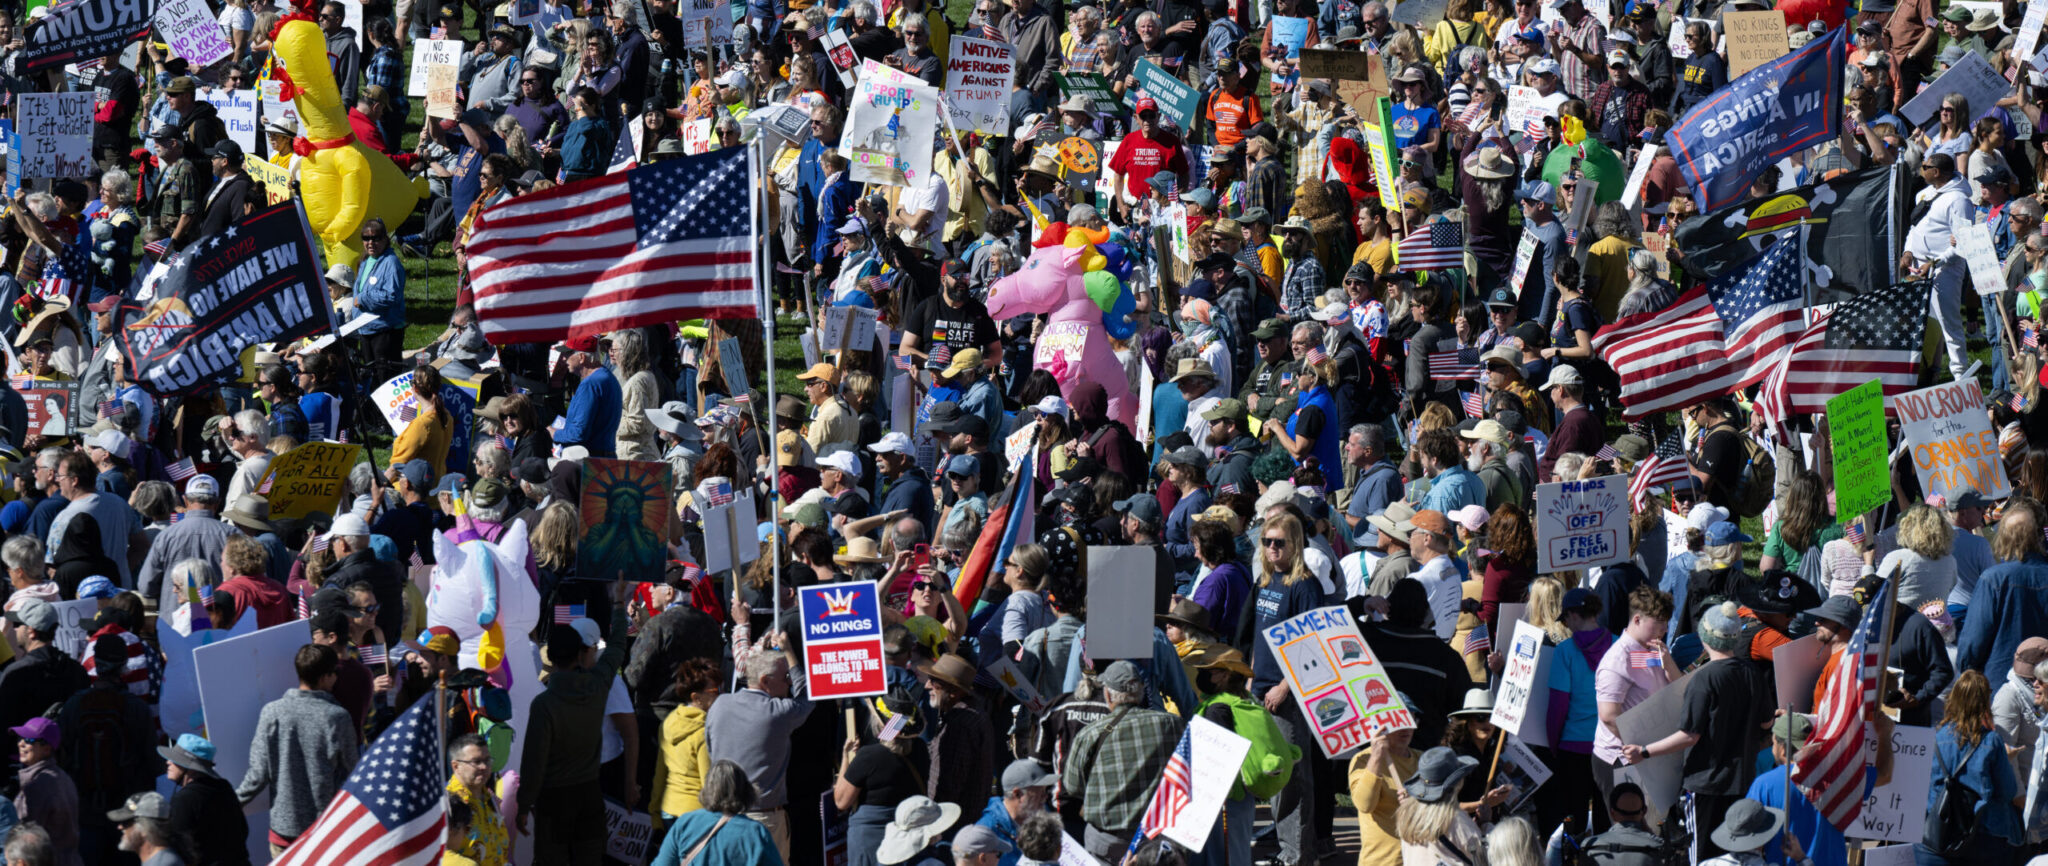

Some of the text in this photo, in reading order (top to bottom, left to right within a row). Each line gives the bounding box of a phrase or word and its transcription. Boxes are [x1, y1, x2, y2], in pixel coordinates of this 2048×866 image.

[1733, 17, 1780, 32] NO KINGS
[171, 18, 219, 54] NO KING
[195, 31, 222, 54] KKK
[1736, 32, 1784, 44] NO DICTATORS
[433, 41, 444, 52] NO
[961, 41, 1010, 59] NATIVE
[1741, 47, 1781, 61] NO FELONS
[422, 53, 450, 64] KINGS
[947, 58, 1012, 74] AMERICANS
[961, 75, 1008, 88] AGAINST
[1145, 67, 1175, 92] EQUALITY
[1172, 84, 1189, 99] AND
[953, 89, 1003, 101] TRUMP
[1146, 80, 1163, 96] LOVE
[1161, 92, 1180, 106] OVER
[25, 96, 50, 117] It's
[214, 96, 252, 112] good King
[28, 117, 58, 137] Left
[230, 119, 254, 132] Flush
[36, 137, 57, 154] It's
[851, 151, 916, 179] CONGRESS
[266, 170, 287, 187] Like
[1647, 237, 1665, 252] Hate
[949, 320, 975, 332] YOU ARE
[947, 328, 976, 343] SAFE
[391, 373, 415, 388] THE
[1894, 379, 1985, 425] NO CROWN
[1931, 419, 1967, 438] for the
[274, 444, 354, 471] LIBERTY
[1914, 430, 1997, 471] ORANGE
[281, 464, 340, 478] FOR ALL
[287, 481, 336, 498] SOME
[1571, 514, 1598, 528] OFF
[1569, 533, 1603, 548] FREE
[1560, 543, 1609, 561] SPEECH
[1256, 598, 1280, 612] CHANGE
[811, 619, 872, 635] NO KINGS
[1269, 608, 1349, 647] SAME ACT
[820, 648, 869, 664] THE POWER
[811, 657, 880, 676] BELONGS TO THE
[831, 672, 863, 685] PEOPLE
[1503, 679, 1528, 708] TRUMP
[1321, 708, 1412, 756] DIFF HAT
[1890, 731, 1927, 757] Since
[1889, 792, 1903, 811] It
[1862, 813, 1905, 838] Way!
[624, 841, 647, 859] NO
